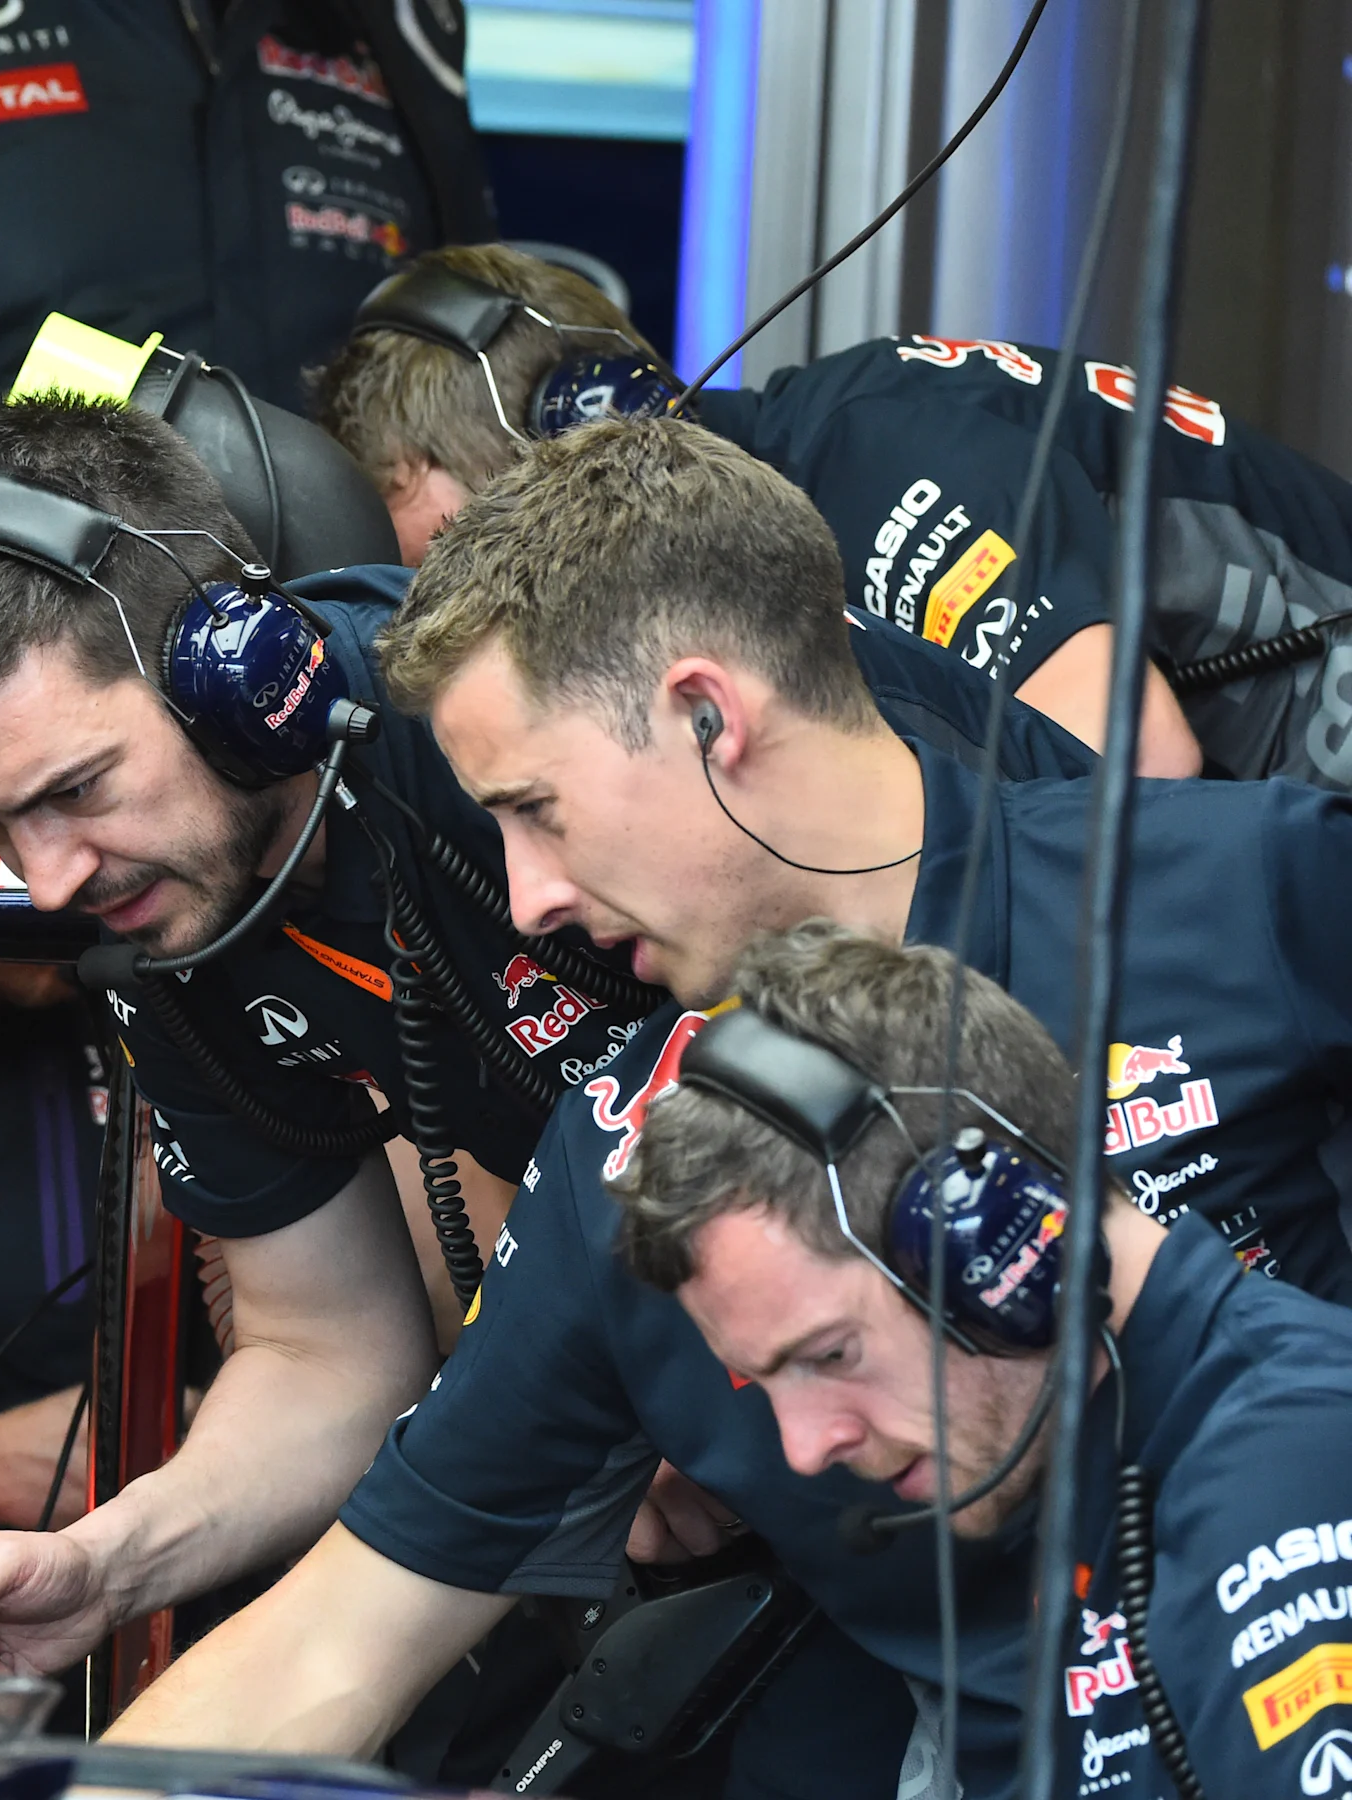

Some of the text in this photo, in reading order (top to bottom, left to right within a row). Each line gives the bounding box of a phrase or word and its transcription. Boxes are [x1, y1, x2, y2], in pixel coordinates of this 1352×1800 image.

[863, 478, 942, 619] CASIO
[894, 504, 972, 634] RENAULT
[320, 953, 385, 989] STARTING
[505, 984, 590, 1058] Red
[1124, 1078, 1220, 1149] Bull
[1132, 1153, 1220, 1215] Jeans
[1230, 1585, 1352, 1669] RENAU
[515, 1738, 563, 1793] OLYMPUS
